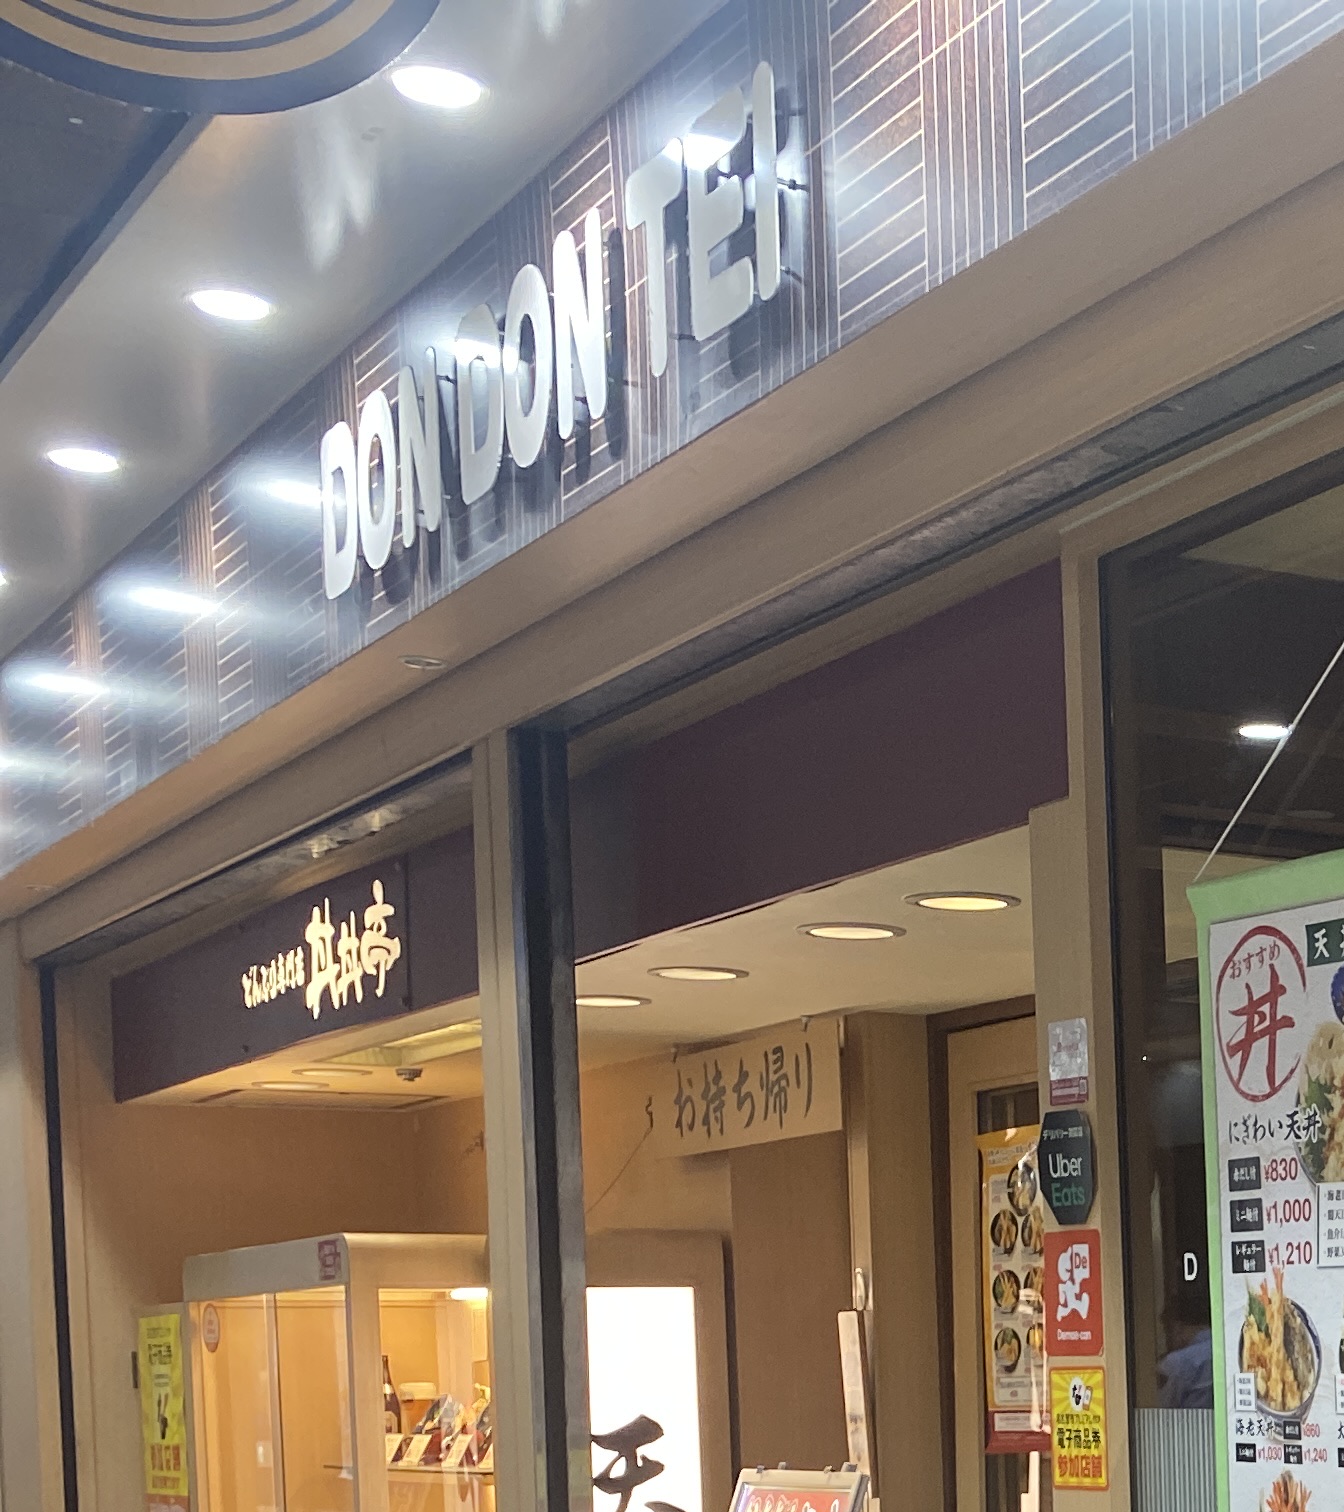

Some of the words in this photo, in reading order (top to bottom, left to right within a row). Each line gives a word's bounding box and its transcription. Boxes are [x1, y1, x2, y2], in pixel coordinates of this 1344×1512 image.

[321, 346, 440, 600] DON
[455, 207, 607, 505] DON
[626, 60, 779, 378] TEI
[1229, 940, 1281, 980] おすすめ
[1226, 963, 1295, 1093] 丼
[674, 1042, 813, 1138] お持ち帰り
[1228, 1106, 1320, 1145] にぎわい天丼
[1049, 1153, 1082, 1178] Uber
[1264, 1157, 1298, 1182] ¥830
[1051, 1182, 1085, 1207] Eats
[1266, 1198, 1312, 1227] ¥1,000
[1074, 1252, 1088, 1269] De
[1268, 1241, 1312, 1268] ¥1,210
[1057, 1426, 1101, 1450] 電子商品券
